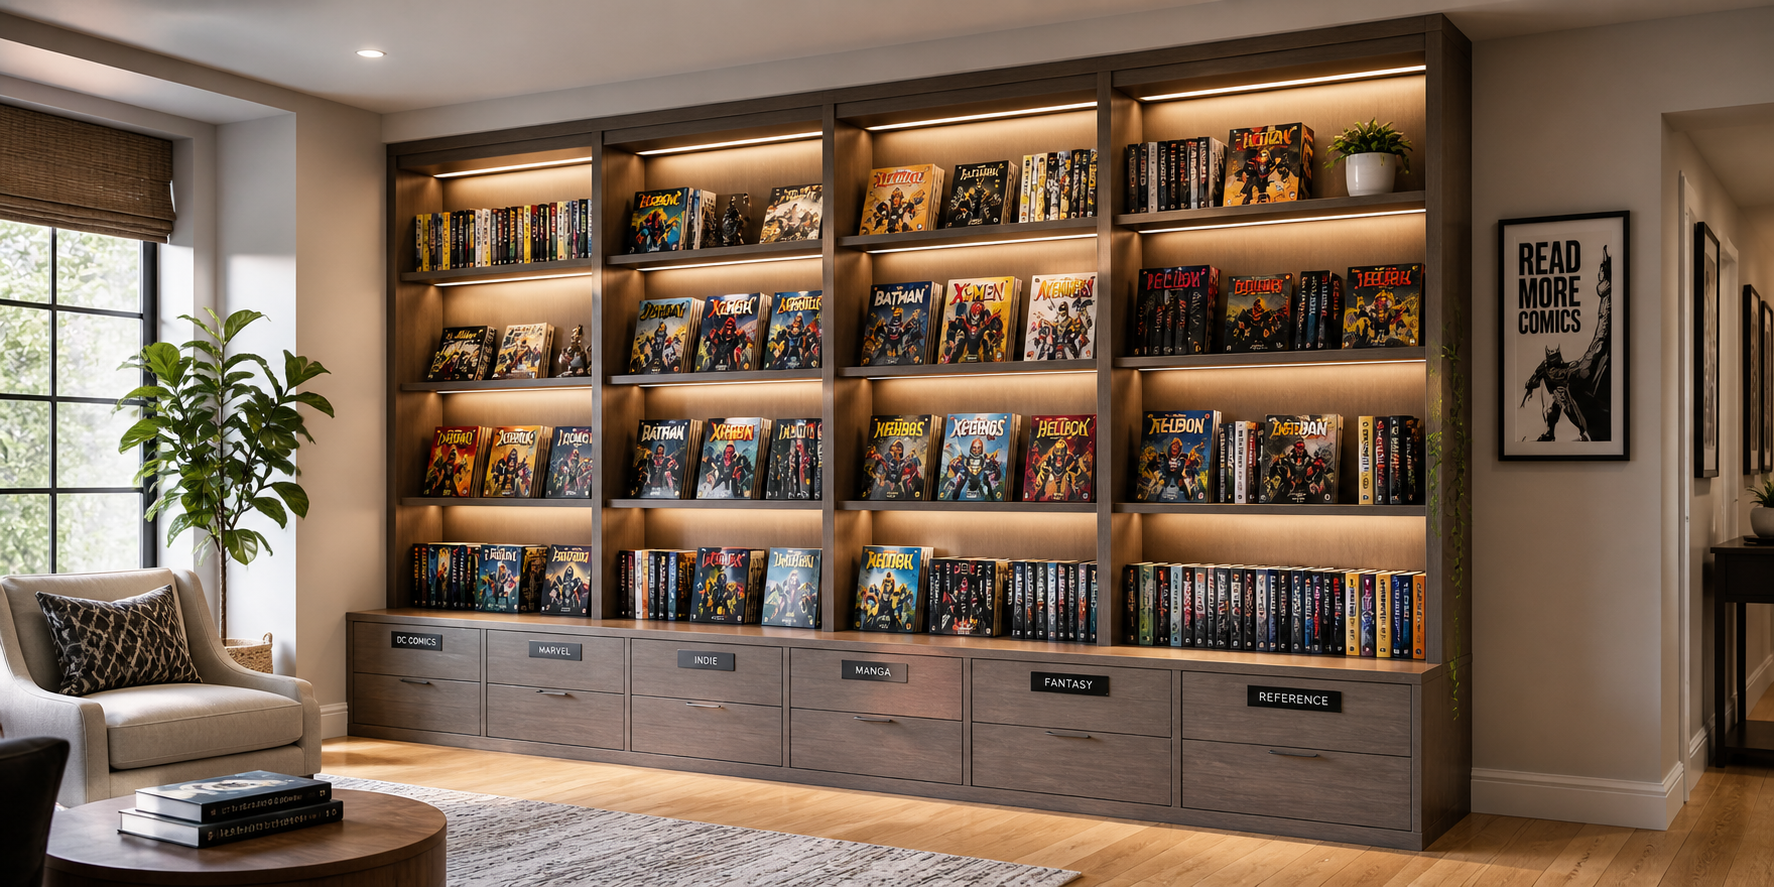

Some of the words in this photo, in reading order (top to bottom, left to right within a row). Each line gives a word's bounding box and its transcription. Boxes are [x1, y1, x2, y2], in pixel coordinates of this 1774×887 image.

[1518, 239, 1581, 276] READ
[1518, 275, 1581, 309] MORE
[1518, 308, 1581, 335] COMICS
[396, 635, 408, 645] DC
[408, 636, 437, 646] COMICS
[538, 646, 571, 656] MARVEL
[694, 655, 718, 666] INDIE
[855, 665, 892, 677] MANGA
[1044, 677, 1093, 690] FANTASY
[1259, 691, 1329, 706] REFERENCE
